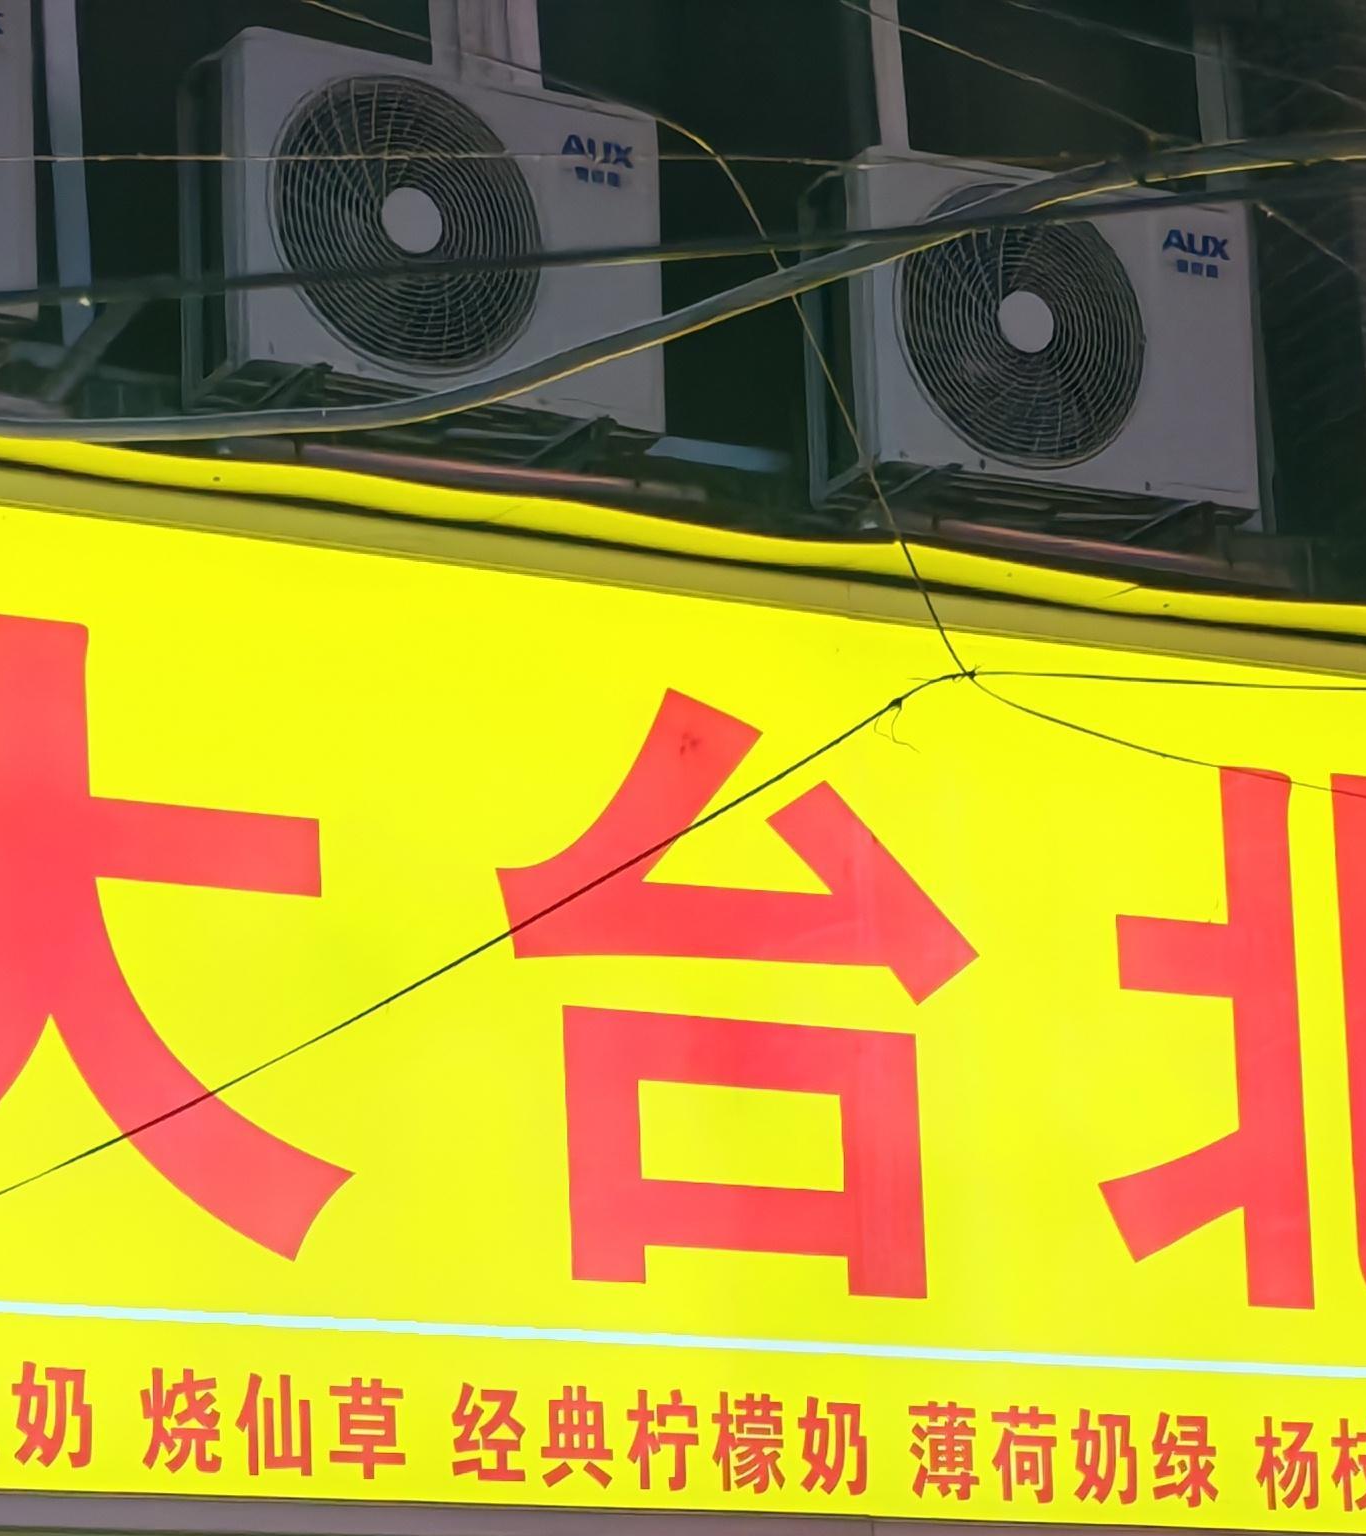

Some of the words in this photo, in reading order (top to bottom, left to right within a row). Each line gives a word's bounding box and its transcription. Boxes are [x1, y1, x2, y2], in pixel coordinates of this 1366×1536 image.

[561, 134, 633, 169] AUX
[1162, 229, 1231, 260] AUX
[141, 1368, 406, 1480] 烧仙草
[451, 1382, 868, 1497] 经典柠檬奶
[910, 1401, 1218, 1506] 薄荷奶绿
